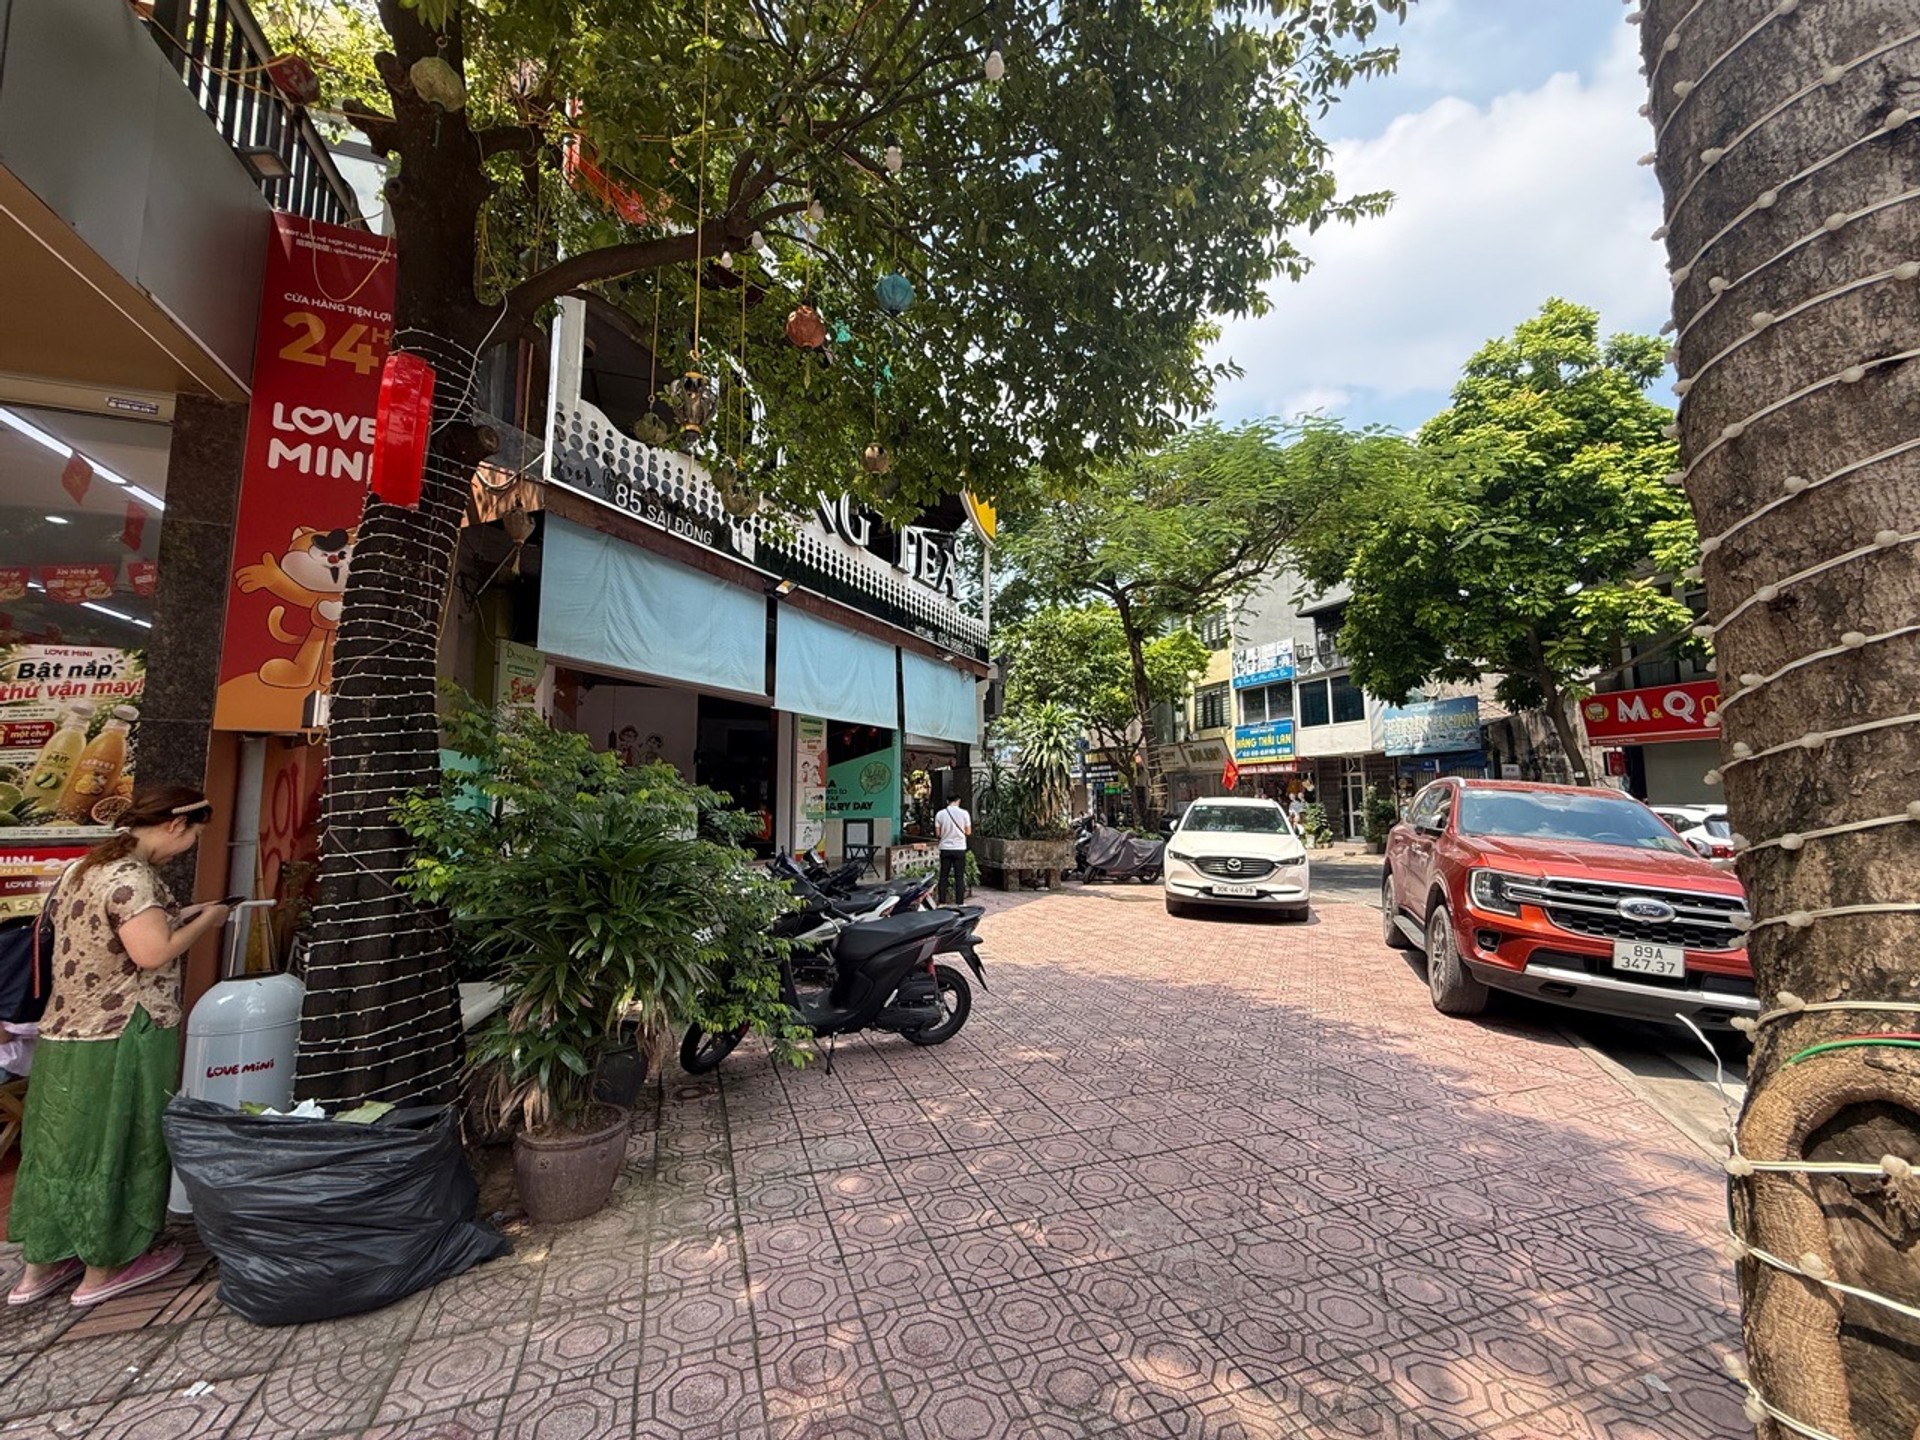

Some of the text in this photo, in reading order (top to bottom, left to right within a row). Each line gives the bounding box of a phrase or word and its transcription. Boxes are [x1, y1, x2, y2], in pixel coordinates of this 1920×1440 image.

[283, 292, 392, 322] CỬA HÀNG TIỆN LỢI
[272, 401, 377, 445] LOVE
[615, 482, 713, 546] 85 SÀI ĐỒNG
[892, 517, 959, 601] TEA
[44, 648, 93, 658] LOVE MINI
[17, 658, 117, 682] Bật nắp,
[0, 677, 144, 701] thử vận may!
[10, 730, 50, 740] một chai
[853, 801, 873, 811] DAY
[5, 881, 33, 889] LOVE
[1633, 945, 1664, 960] 89A
[1620, 956, 1676, 974] 347.37
[206, 1064, 240, 1078] LOVE
